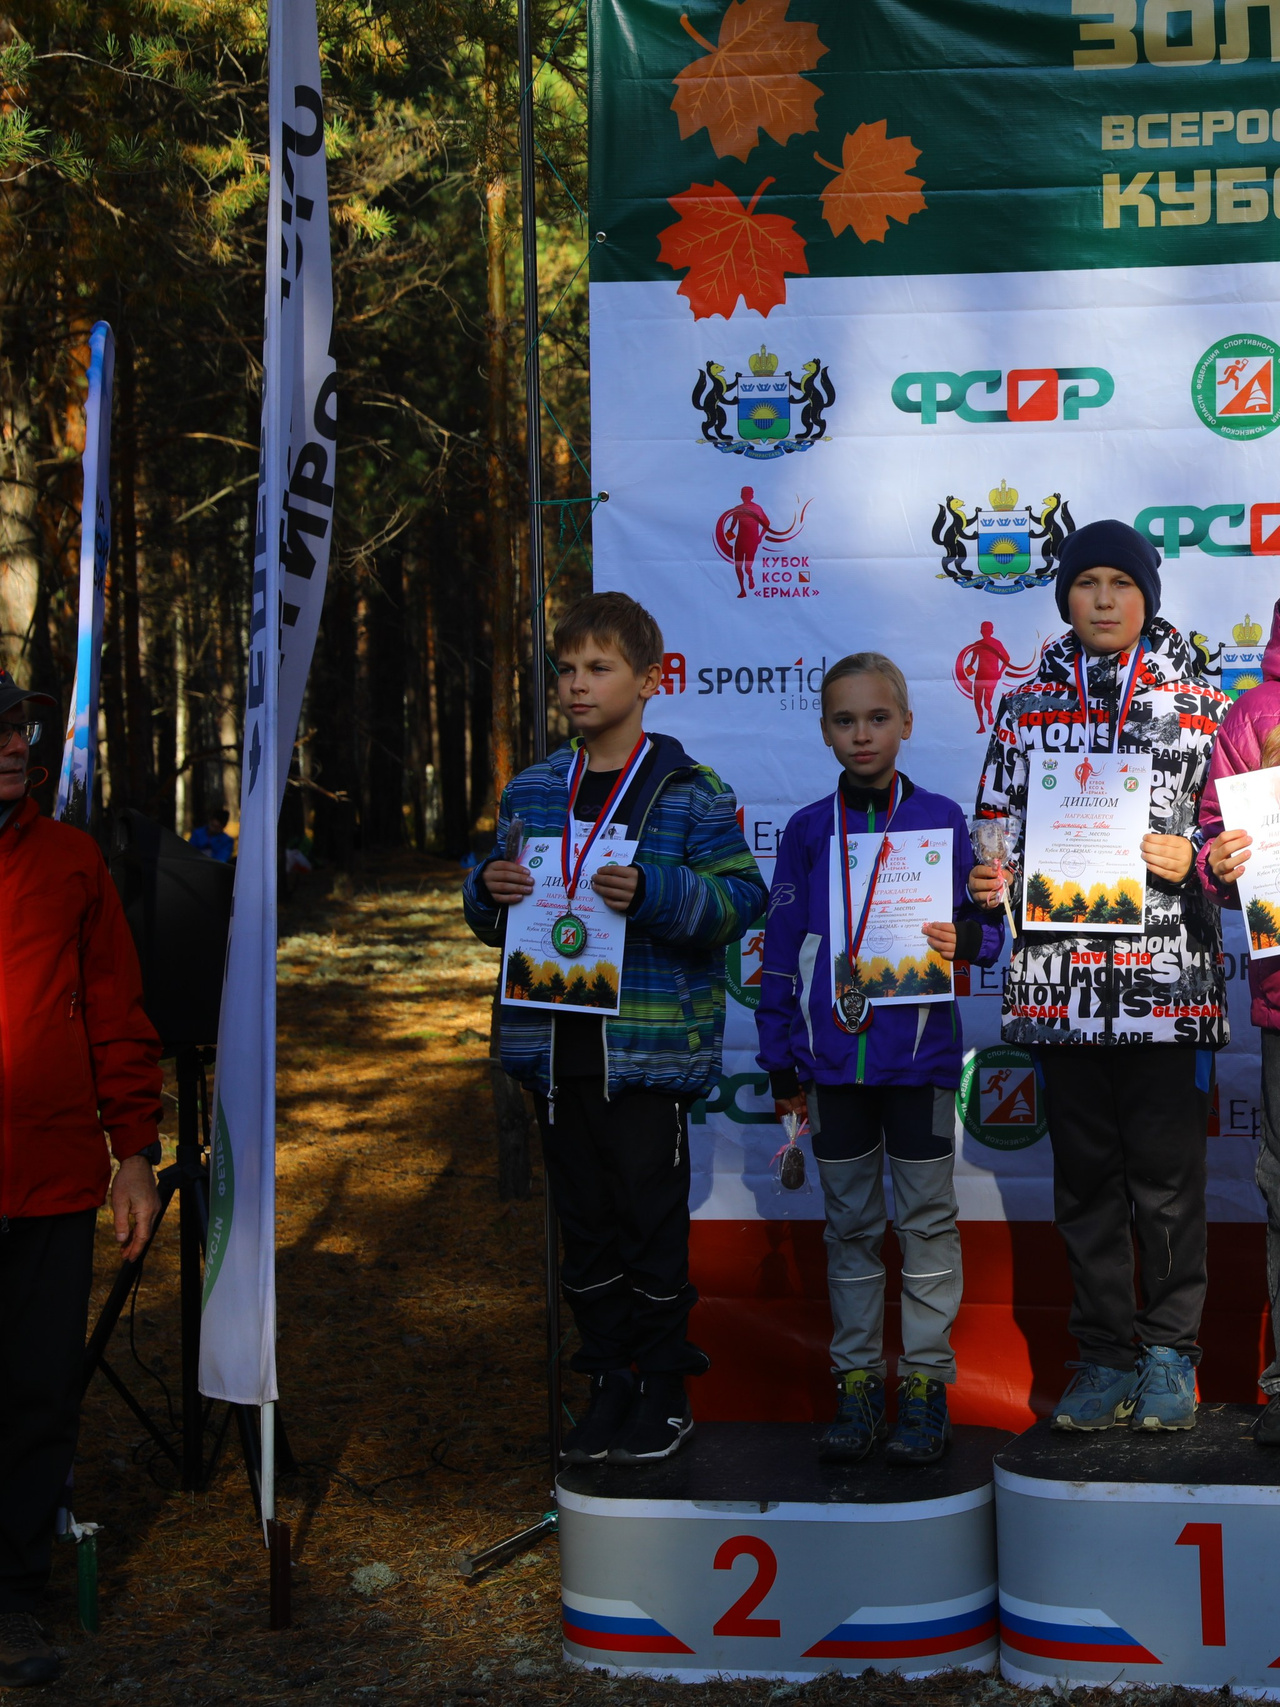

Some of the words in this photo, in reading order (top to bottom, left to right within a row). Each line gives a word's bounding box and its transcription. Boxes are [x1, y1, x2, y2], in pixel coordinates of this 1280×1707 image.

[1223, 338, 1276, 355] СПОРТИВНОГО
[762, 556, 810, 568] КУБОК
[762, 572, 793, 583] КСО
[754, 587, 820, 599] «ЕРМАК»
[697, 656, 826, 695] SPORTid
[780, 695, 821, 711] sibe
[1060, 797, 1119, 808] ДИПЛОМ
[1114, 936, 1181, 953] SNOW
[712, 1535, 781, 1638] 2
[1174, 1522, 1226, 1646] 1
